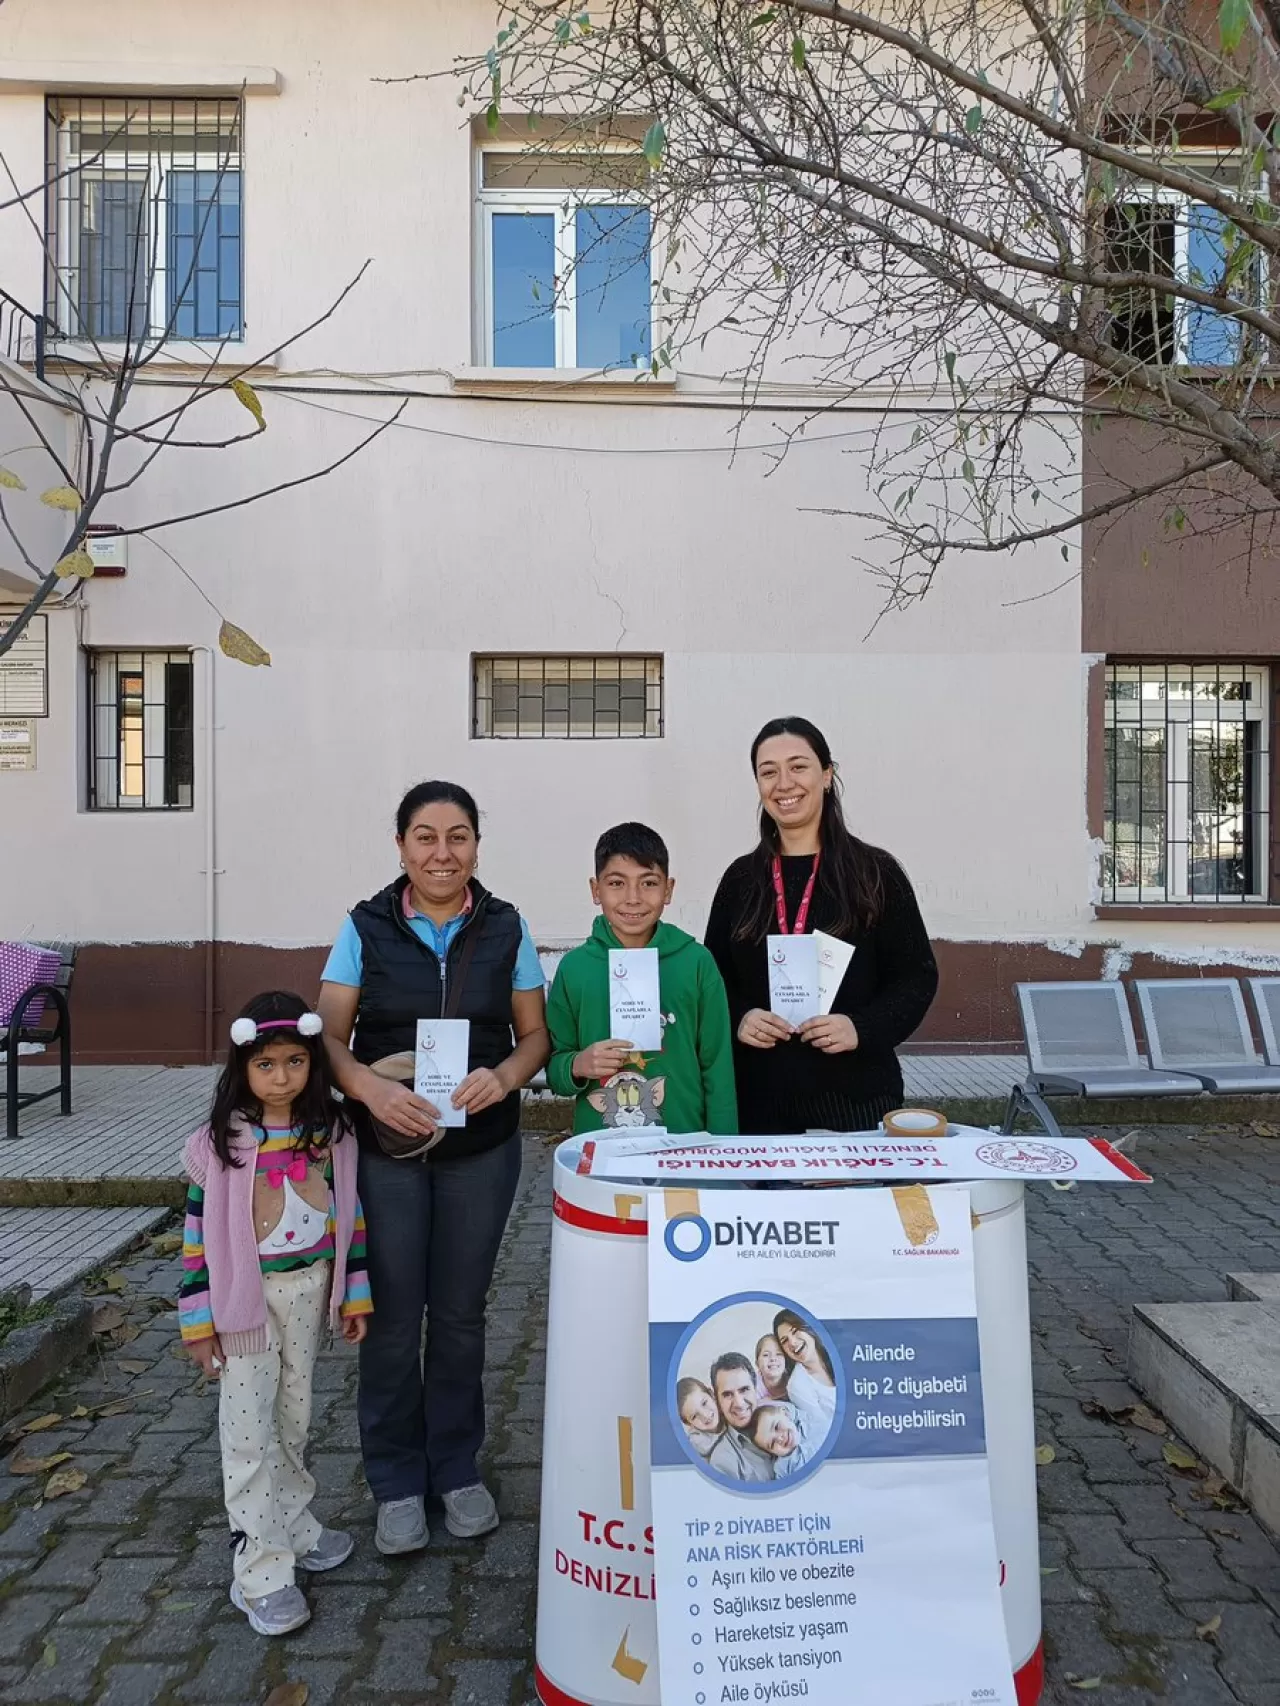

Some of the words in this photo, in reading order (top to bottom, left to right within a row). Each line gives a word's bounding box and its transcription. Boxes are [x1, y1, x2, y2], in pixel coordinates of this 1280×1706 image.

[772, 1145, 838, 1154] SAĞLIK
[863, 1145, 938, 1153] DENİZLİ
[658, 1158, 797, 1170] BAKANLIĞI
[804, 1157, 894, 1169] SAĞLIK
[897, 1158, 948, 1167] T.C.
[714, 1216, 840, 1246] DİYABET
[737, 1249, 756, 1259] HER
[852, 1343, 916, 1362] Ailende
[853, 1377, 879, 1400] tip
[882, 1376, 894, 1394] 2
[897, 1375, 968, 1400] diyabeti
[855, 1408, 967, 1434] önleyebilirsin
[578, 1509, 636, 1551] T.C.
[684, 1517, 711, 1538] TİP
[714, 1520, 725, 1536] 2
[727, 1516, 795, 1536] DİYABET
[797, 1512, 832, 1535] İÇİN
[686, 1546, 721, 1563] ANA
[724, 1541, 763, 1561] RİSK
[766, 1535, 865, 1559] FAKTÖRLERİ
[555, 1548, 656, 1601] DENİZLİ
[711, 1569, 746, 1590] Aşırı
[750, 1566, 776, 1584] kilo
[779, 1567, 798, 1582] ve
[801, 1562, 856, 1581] obezite
[713, 1596, 782, 1618] Sağlıksız
[784, 1592, 857, 1610] beslenme
[715, 1621, 796, 1644] Hareketsiz
[799, 1620, 849, 1642] yaşam
[717, 1651, 775, 1673] Yüksek
[778, 1648, 843, 1670] tansiyon
[720, 1684, 750, 1703] Aile
[753, 1678, 809, 1704] öyküsü
